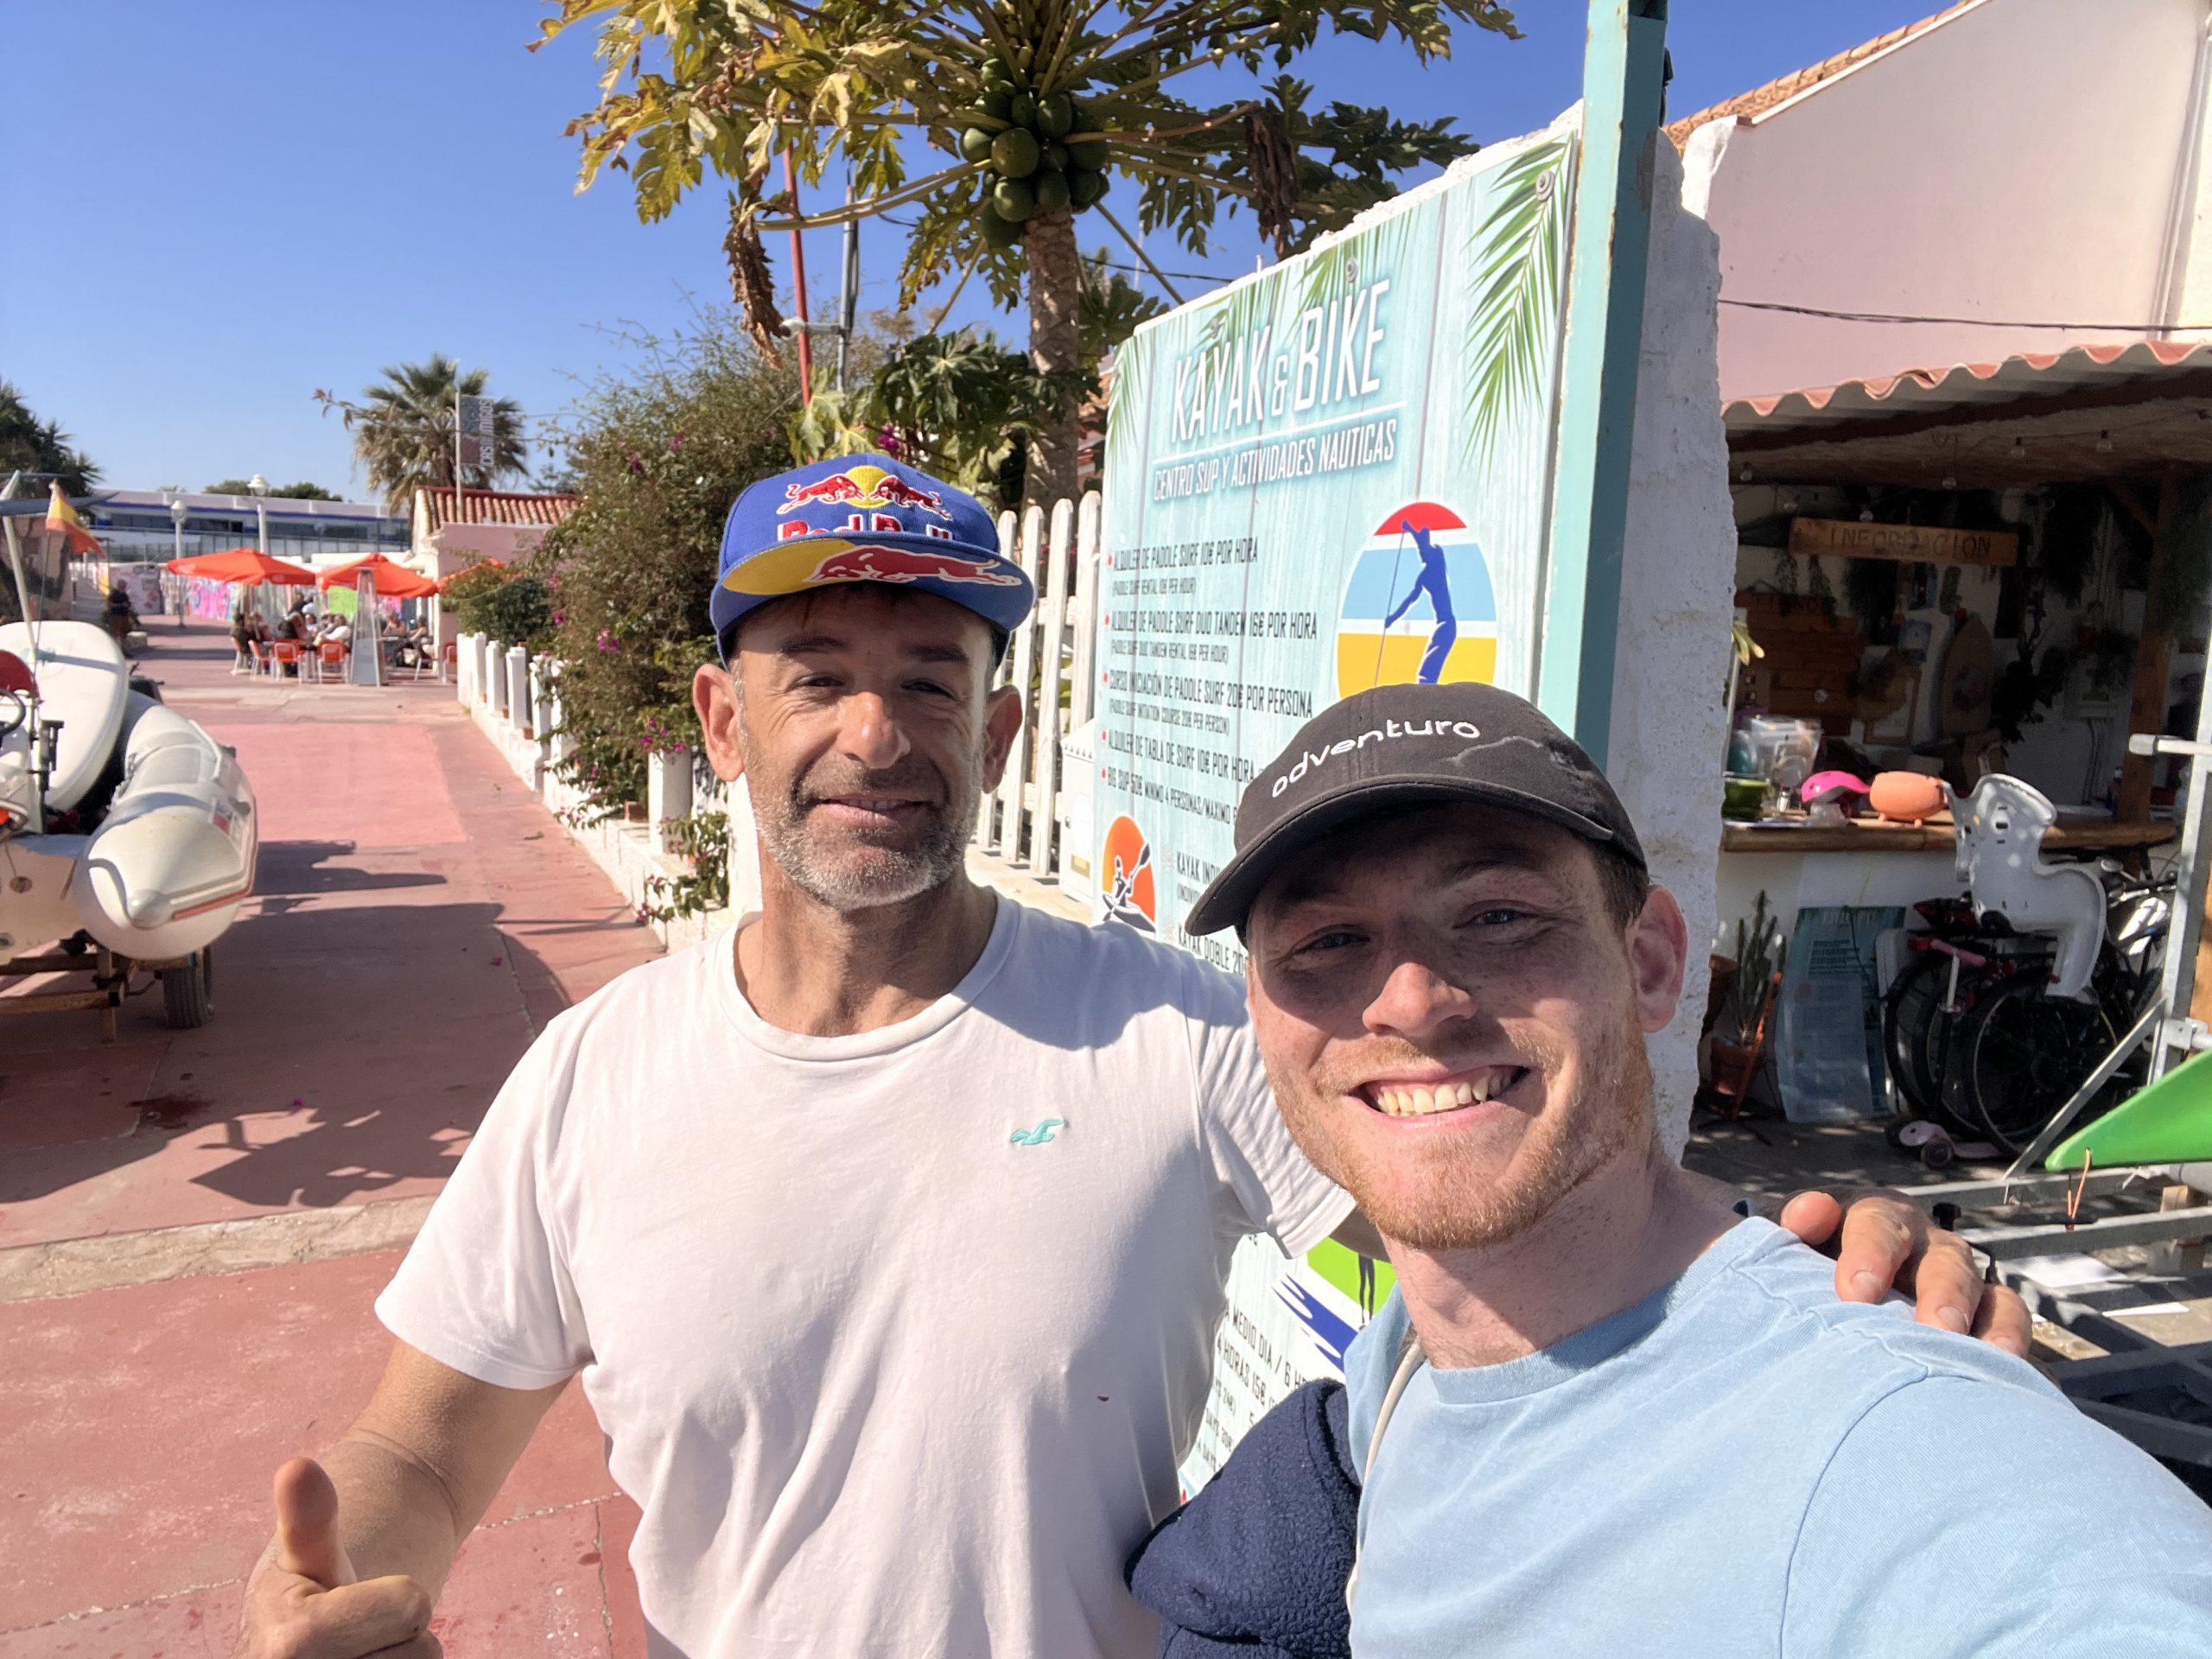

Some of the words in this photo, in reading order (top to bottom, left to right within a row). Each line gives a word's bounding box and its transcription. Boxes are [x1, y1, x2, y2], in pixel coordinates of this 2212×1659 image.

[1171, 325, 1271, 443] KAYAK
[1271, 355, 1289, 417] &
[1293, 278, 1390, 411] BIKE
[1154, 462, 1193, 501] CENTRO
[1196, 457, 1220, 493] SUP
[1222, 455, 1231, 488] Y
[1230, 437, 1316, 487] ACTIVIDADES
[1319, 419, 1397, 473] NAUTICAS
[1216, 539, 1233, 564] POR
[1235, 537, 1258, 563] HORA
[1214, 611, 1247, 637] TANDEM
[1249, 611, 1265, 637] 16€
[1267, 612, 1287, 639] POR
[1289, 611, 1318, 639] HORA
[1164, 676, 1173, 698] DE
[1175, 676, 1202, 702] PADDLE
[1205, 679, 1224, 706] SURF
[1227, 682, 1243, 709] 20€
[1246, 683, 1265, 711] POR
[1268, 687, 1313, 719] PERSONA
[1145, 737, 1165, 763] TABLA
[1166, 741, 1175, 765] DE
[1176, 744, 1196, 770] SURF
[1212, 752, 1229, 779] POR
[1231, 756, 1255, 784] HORA
[1177, 851, 1200, 882] KAYAK
[1205, 936, 1230, 970] DOBLE
[1233, 1304, 1256, 1350] MEDIO
[1259, 1332, 1273, 1369] DIA
[1284, 1361, 1291, 1388] 6
